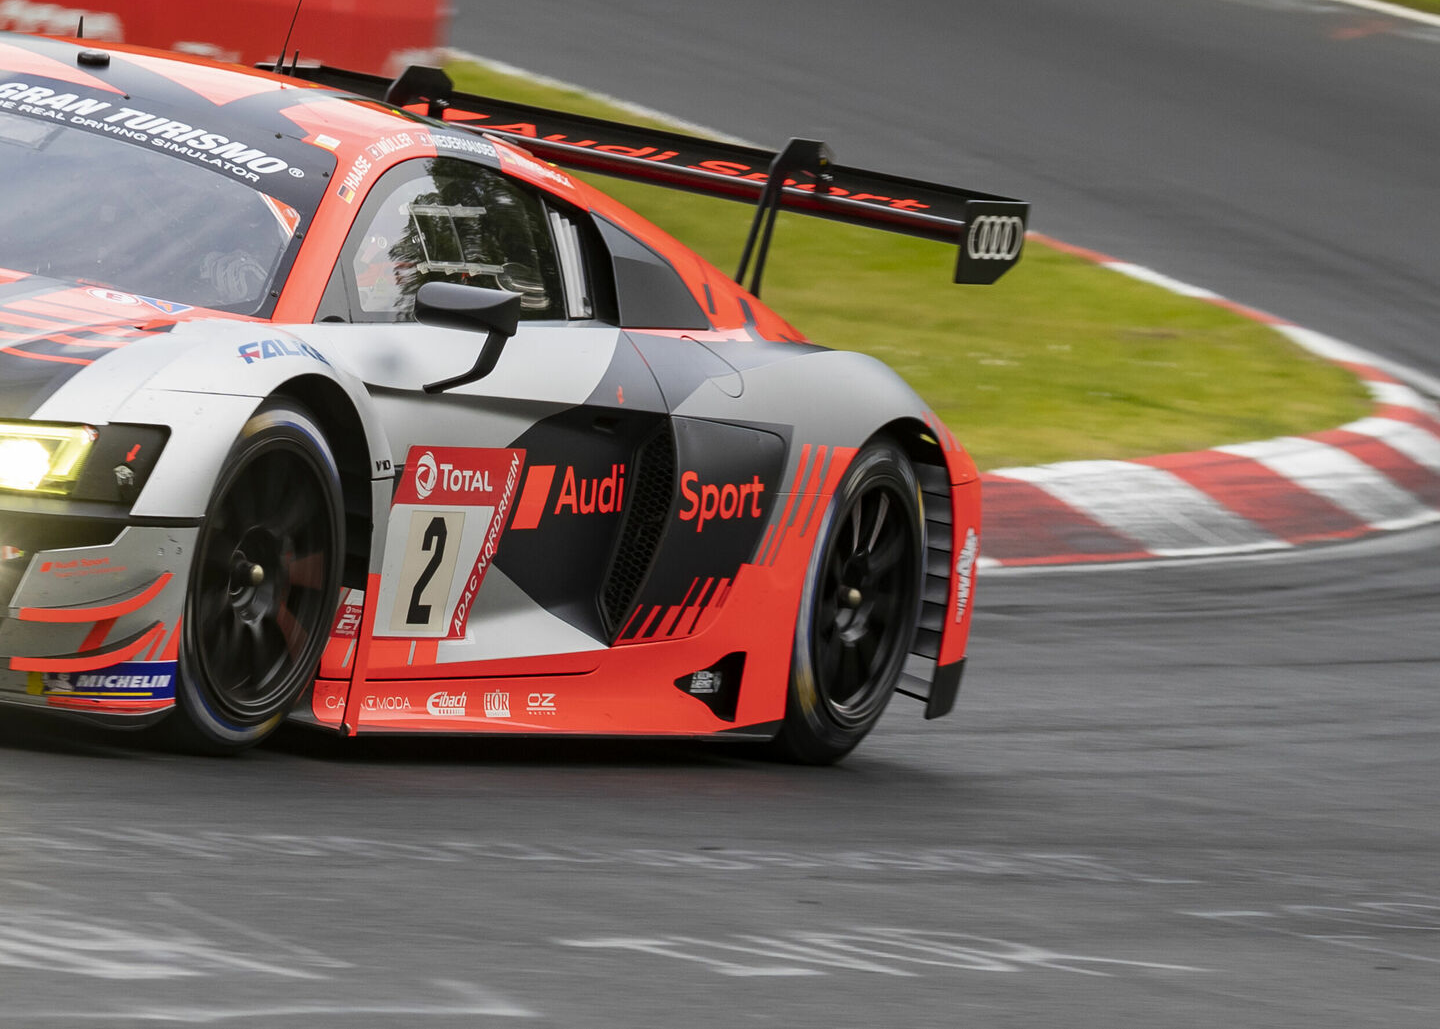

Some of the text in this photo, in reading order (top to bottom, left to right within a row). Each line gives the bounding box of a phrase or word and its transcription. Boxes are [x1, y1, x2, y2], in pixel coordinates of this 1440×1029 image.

[18, 103, 67, 122] REAL
[70, 115, 149, 143] DRIVING
[151, 137, 261, 184] SIMULATOR
[103, 107, 289, 174] TURISMO
[344, 155, 373, 191] HAASE
[478, 121, 931, 213] Audi Sport
[554, 464, 765, 533] Audi Sport
[406, 517, 448, 625] 2
[453, 452, 521, 636] ADAC NORDRHEIN
[76, 674, 172, 689] MICHELIN
[426, 691, 468, 714] Eibach
